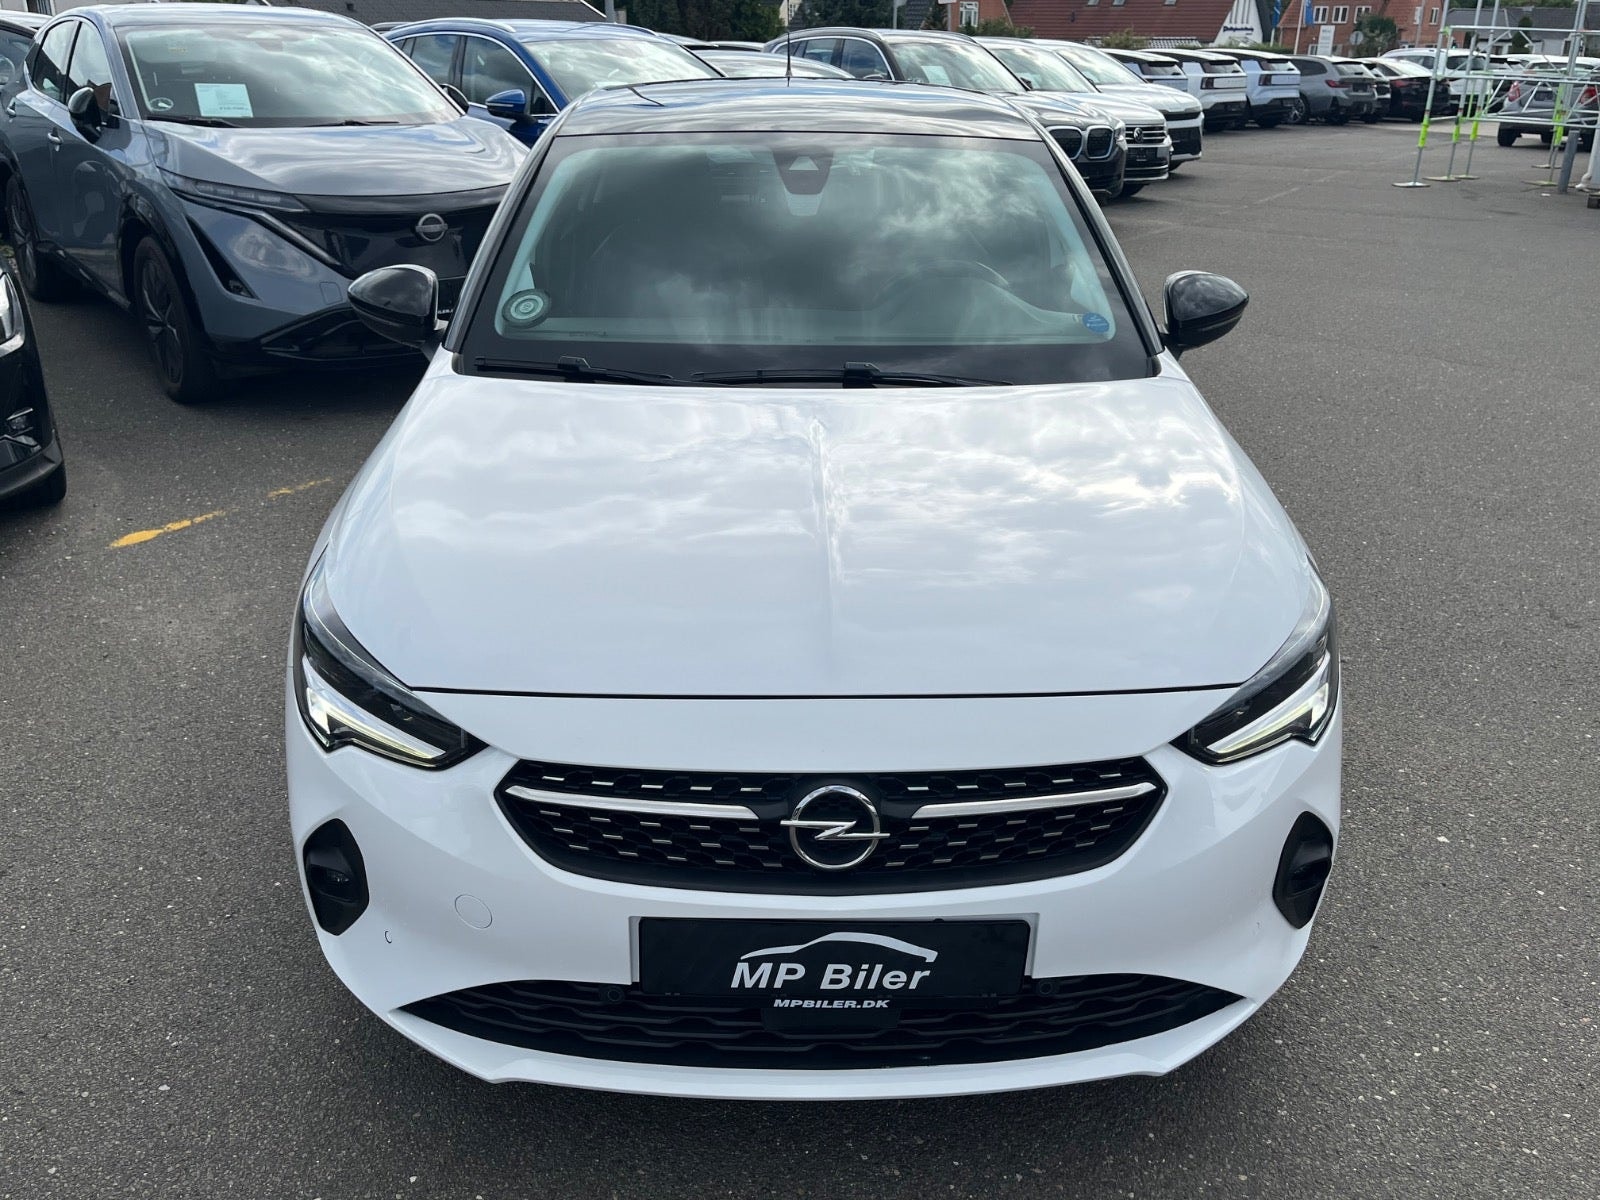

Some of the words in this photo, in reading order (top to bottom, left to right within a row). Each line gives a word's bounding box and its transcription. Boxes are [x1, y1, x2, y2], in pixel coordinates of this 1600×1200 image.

[731, 962, 805, 989] MP
[820, 964, 930, 990] Biler
[773, 999, 890, 1009] MPBILER.DK
